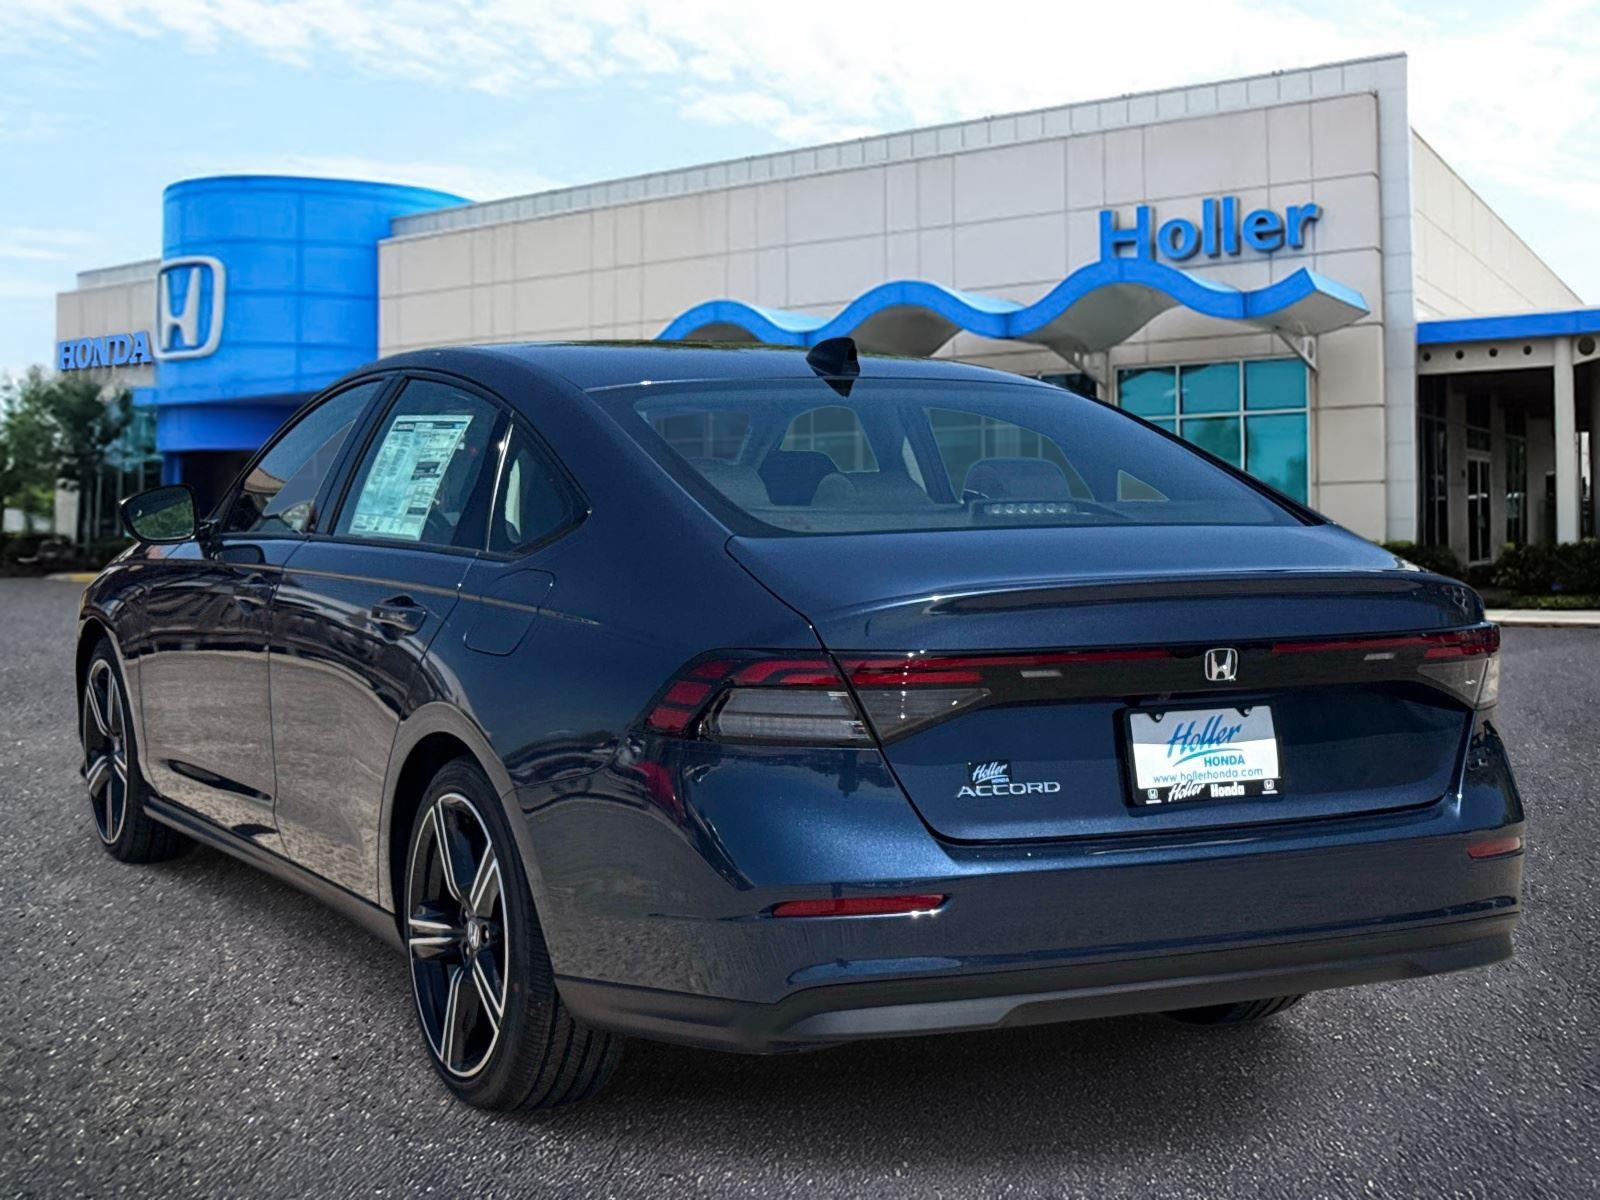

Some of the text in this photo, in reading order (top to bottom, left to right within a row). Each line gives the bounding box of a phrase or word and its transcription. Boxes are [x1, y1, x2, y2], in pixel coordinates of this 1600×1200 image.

[1100, 195, 1322, 261] Holler
[58, 331, 152, 371] HONDA
[1167, 714, 1242, 758] Holler
[1204, 755, 1245, 767] HONDA
[972, 762, 1007, 781] Holler
[1153, 768, 1263, 783] www.hollerhonda.com
[957, 782, 1060, 798] ACCORD
[1168, 780, 1245, 802] Holler Honda
